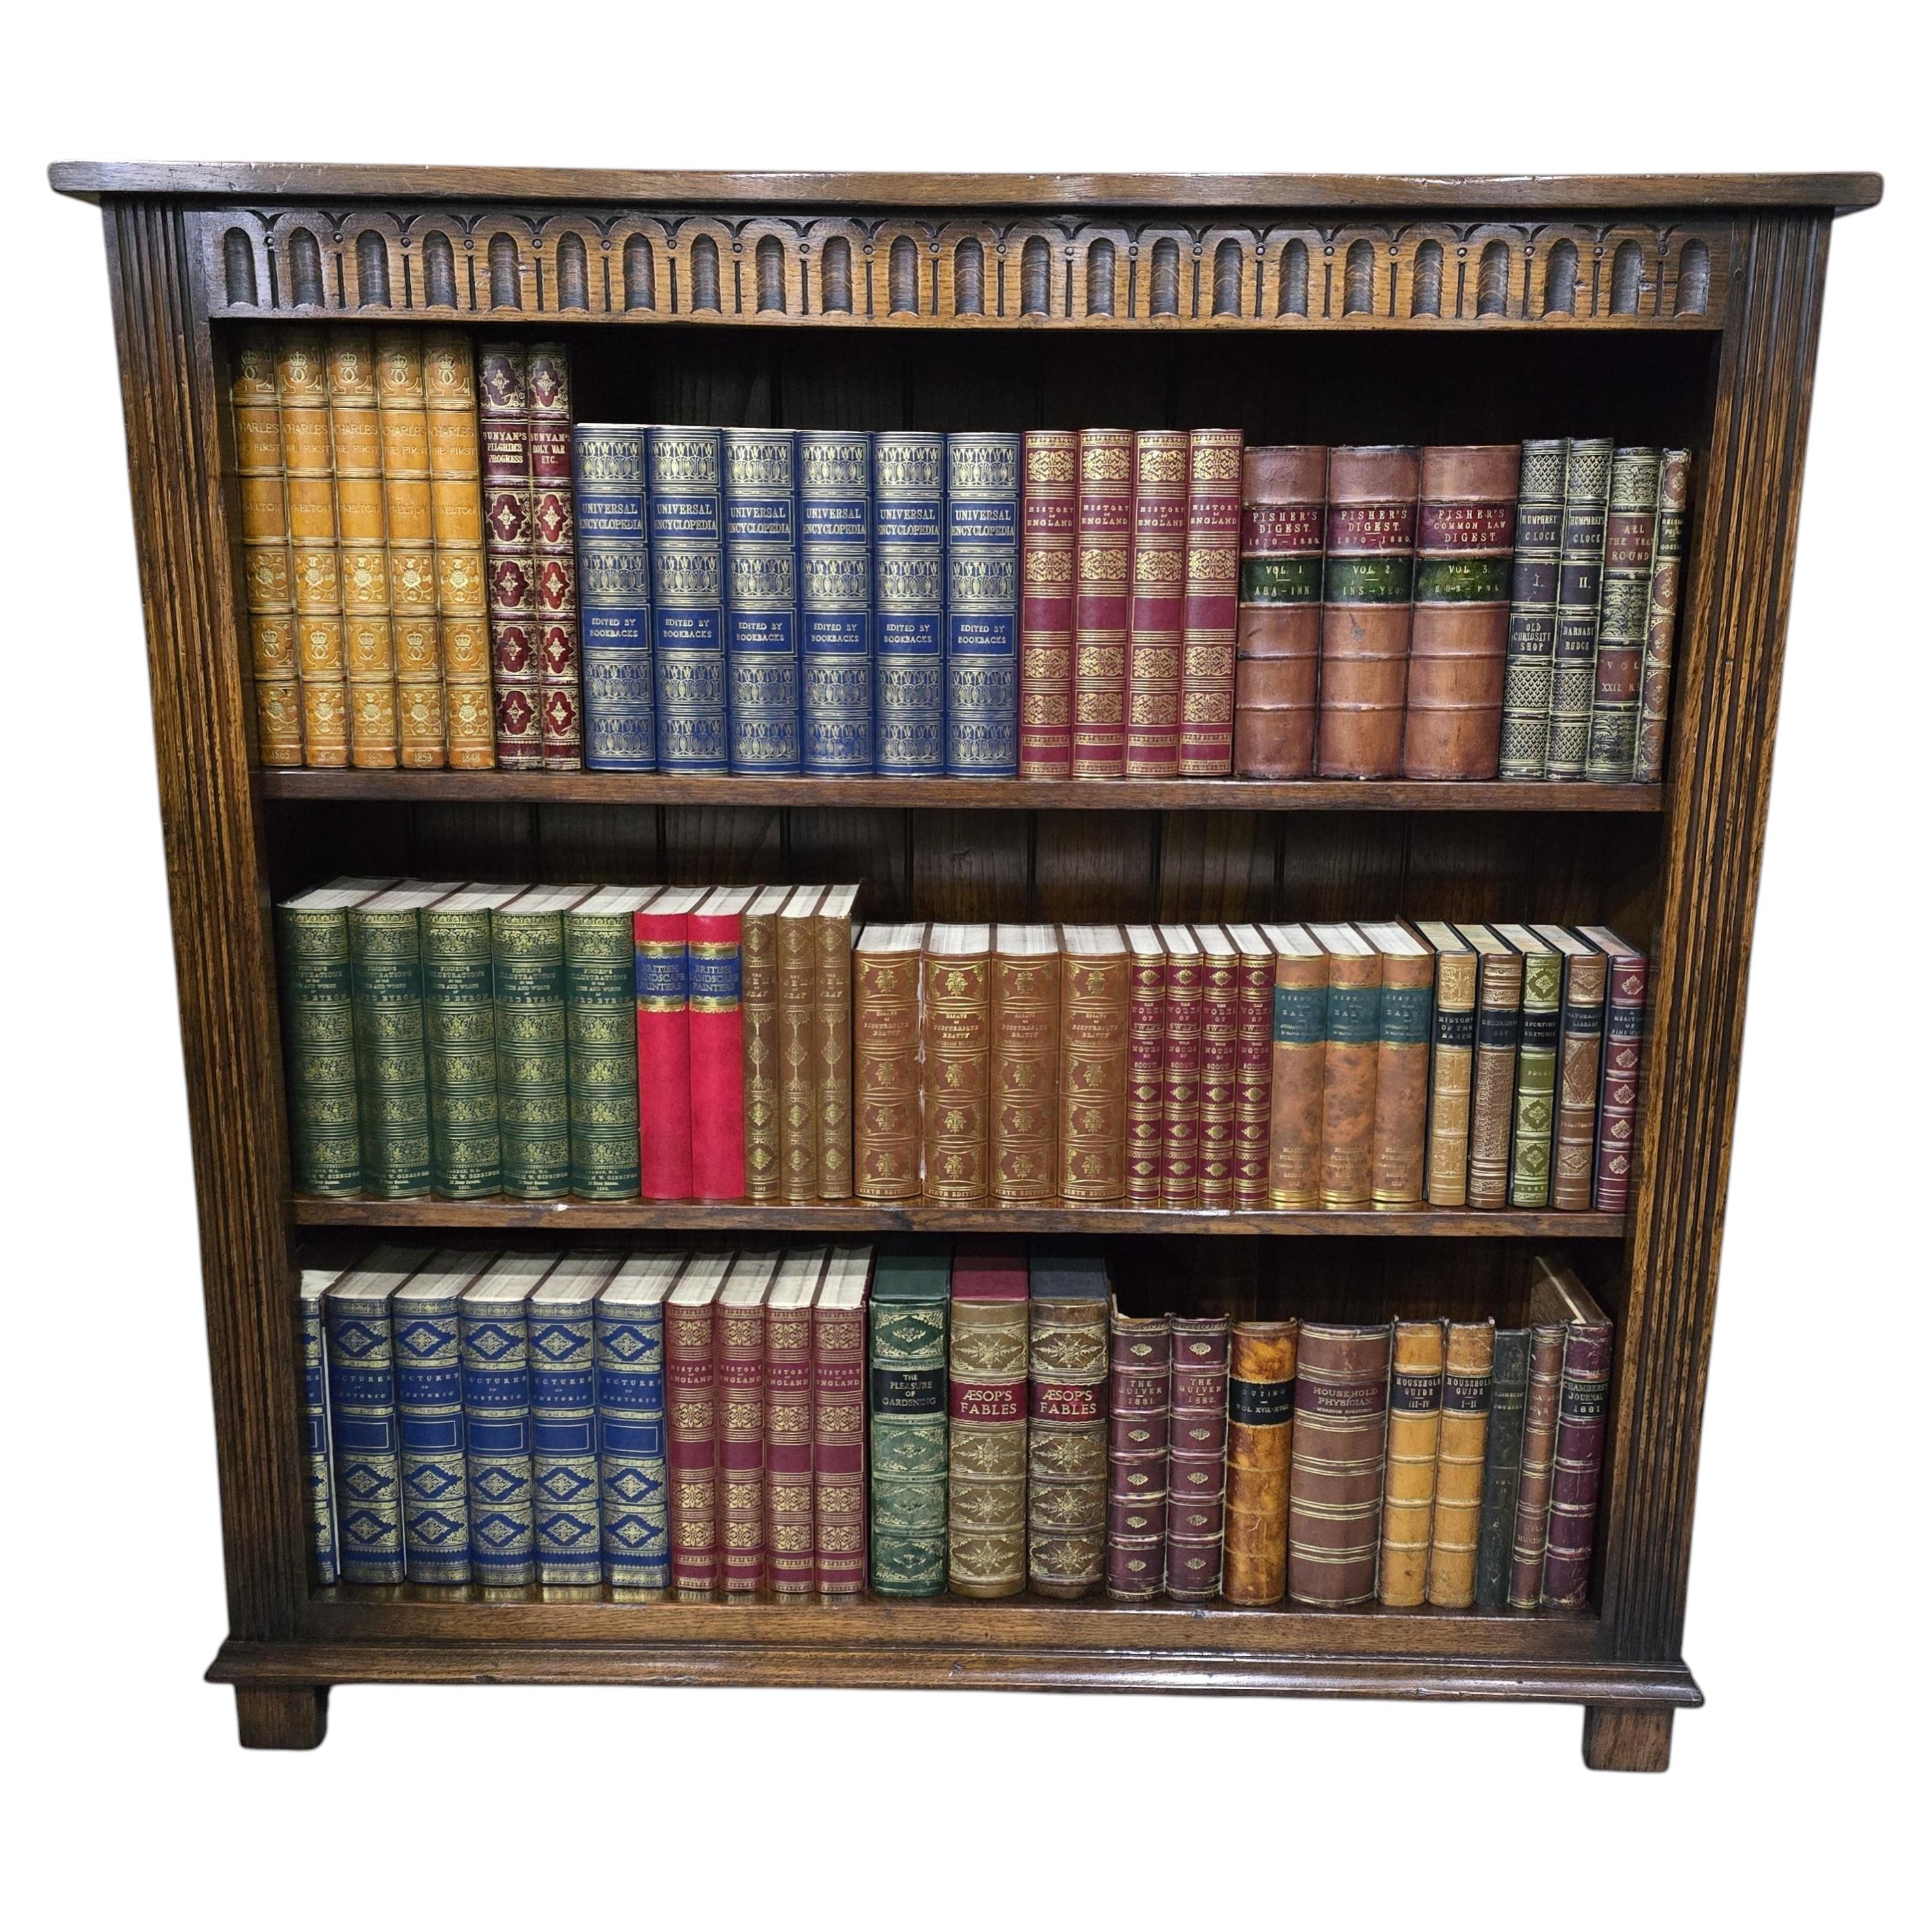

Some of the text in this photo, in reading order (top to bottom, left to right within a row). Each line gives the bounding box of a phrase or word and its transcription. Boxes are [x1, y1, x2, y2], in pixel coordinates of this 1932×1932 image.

[582, 503, 637, 514] UNIVERSAL
[657, 504, 712, 515] UNIVERSAL
[730, 507, 786, 518] UNIVERSAL
[1029, 505, 1073, 514] HISTORY
[807, 508, 861, 519] UNIVERSAL
[880, 509, 935, 520] UNIVERSAL
[955, 510, 1011, 520] UNIVERSAL
[1253, 511, 1318, 522] FISHER'S
[1342, 510, 1408, 520] FISHER'S
[1437, 510, 1505, 519] FISHER'S
[580, 519, 642, 530] ENCYCLOPEDIA
[655, 520, 717, 530] ENCYCLOPEDIA
[1027, 518, 1073, 527] ENGLAND
[1081, 517, 1128, 526] ENGLAND
[1138, 518, 1184, 527] ENGLAND
[1190, 517, 1237, 525] ENGLAND
[728, 522, 790, 534] ENCYCLOPEDIA
[803, 524, 865, 535] ENCYCLOPEDIA
[878, 524, 939, 535] ENCYCLOPEDIA
[952, 525, 1015, 536] ENCYCLOPEDIA
[1434, 522, 1478, 530] COMMON
[1625, 525, 1644, 534] ALL
[1525, 532, 1555, 541] CLOCK
[1573, 534, 1601, 543] CLOCK
[1612, 551, 1649, 561] ROUND
[591, 618, 620, 626] EDITED
[738, 622, 782, 631] EDITED BY
[814, 623, 842, 631] EDITED
[886, 624, 930, 633] EDITED BY
[961, 624, 990, 633] EDITED
[1526, 623, 1541, 632] OLD
[590, 629, 638, 637] BOOKBACKS
[663, 630, 712, 638] BOOKBACKS
[736, 633, 784, 642] BOOKBACKS
[1513, 632, 1551, 641] CURIOSITY
[812, 635, 859, 643] BOOKBACKS
[884, 635, 932, 644] BOOKBACKS
[958, 636, 1006, 644] BOOKBACKS
[1520, 642, 1544, 651] SHOP
[642, 965, 679, 973] BRITISH
[695, 965, 731, 973] BRITISH
[890, 1382, 933, 1390] PLEASURE
[1397, 1378, 1440, 1386] HOUSEHOLD
[963, 1390, 1012, 1401] ÆSOP'S
[1042, 1390, 1093, 1401] ÆSOP'S
[1314, 1387, 1378, 1397] HOUSEHOLD
[1405, 1388, 1433, 1396] GUIDE
[1456, 1387, 1484, 1395] GUIDE
[882, 1397, 936, 1406] GARDENING
[1318, 1397, 1373, 1406] PHYSICIAN
[1568, 1393, 1603, 1401] JOURNAL
[961, 1403, 1016, 1415] FABLES
[1040, 1403, 1097, 1415] FABLES
